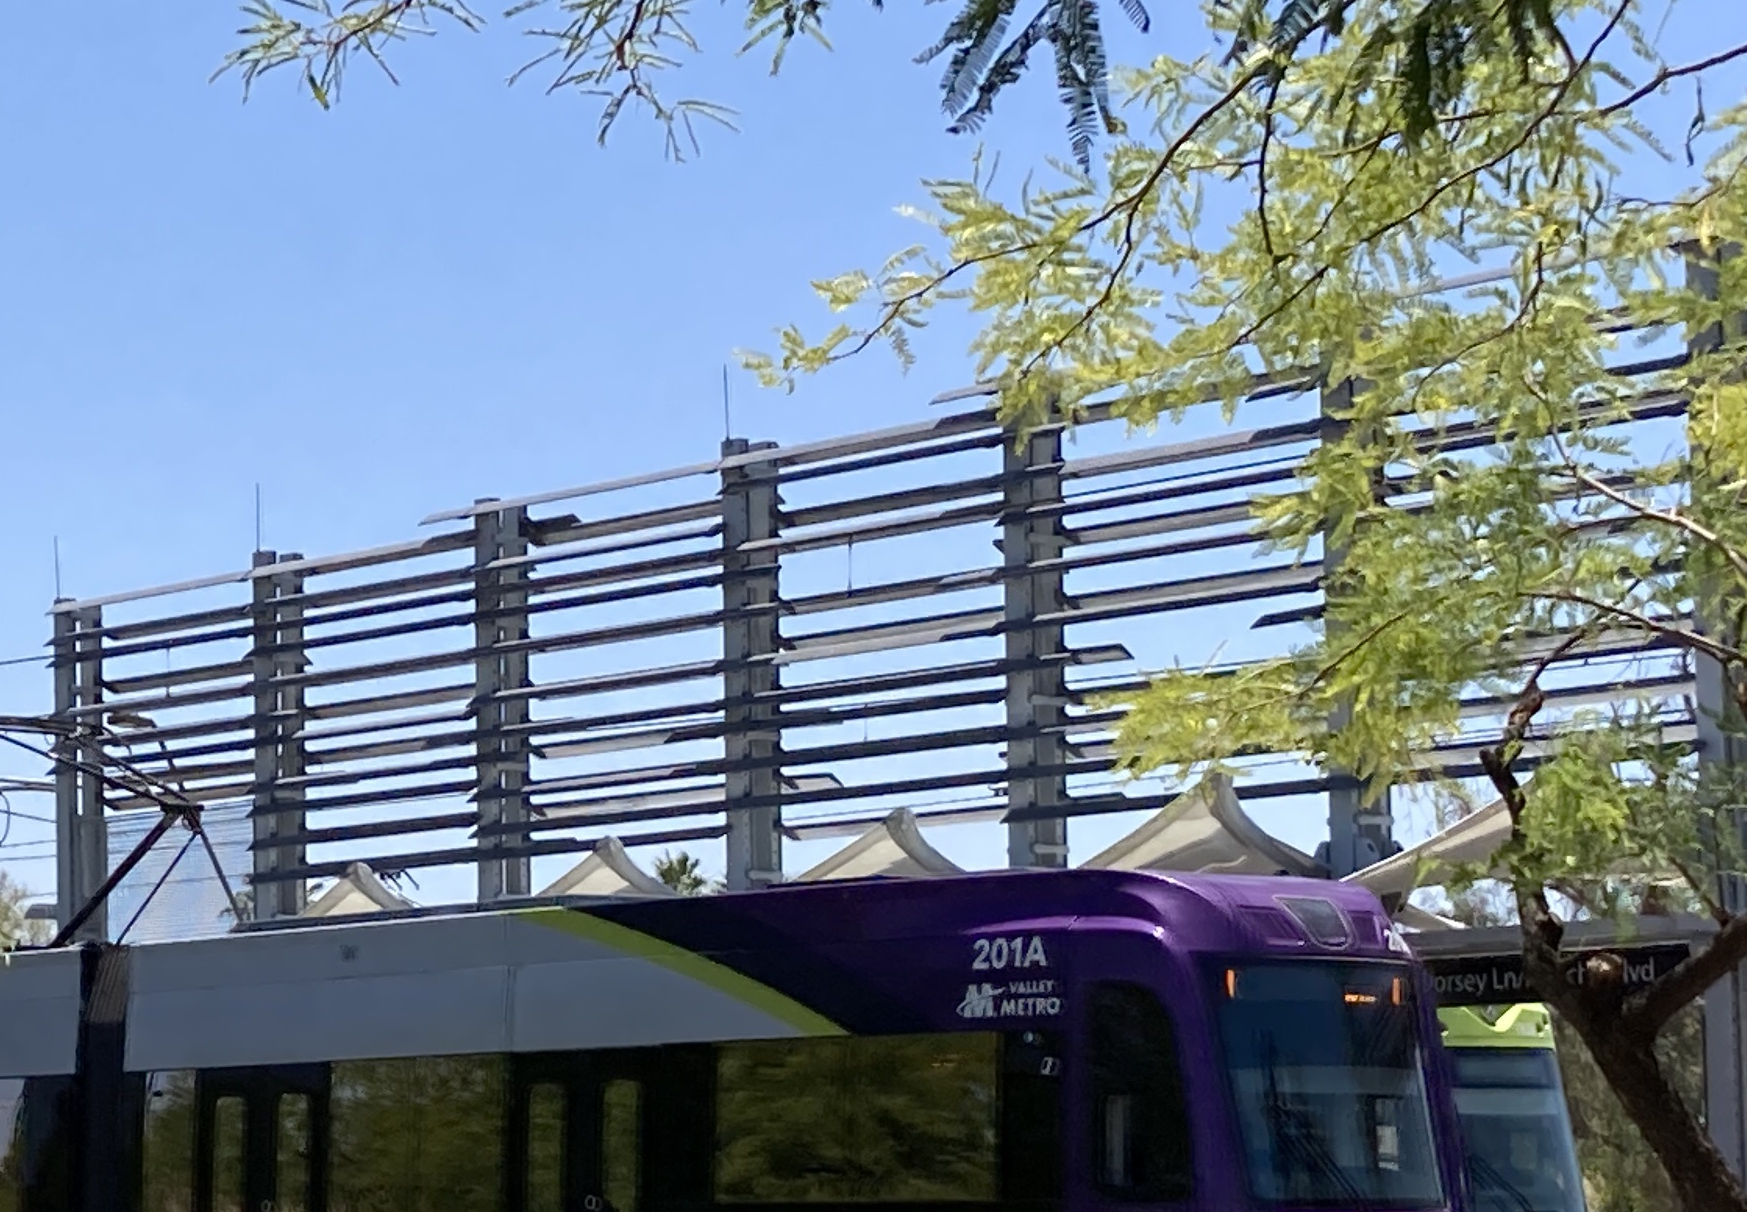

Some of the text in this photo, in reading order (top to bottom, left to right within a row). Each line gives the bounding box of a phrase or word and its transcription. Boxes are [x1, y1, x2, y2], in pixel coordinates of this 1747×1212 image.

[971, 935, 1048, 970] 201A
[1008, 979, 1056, 994] VALLEY
[1000, 997, 1061, 1017] METRO
